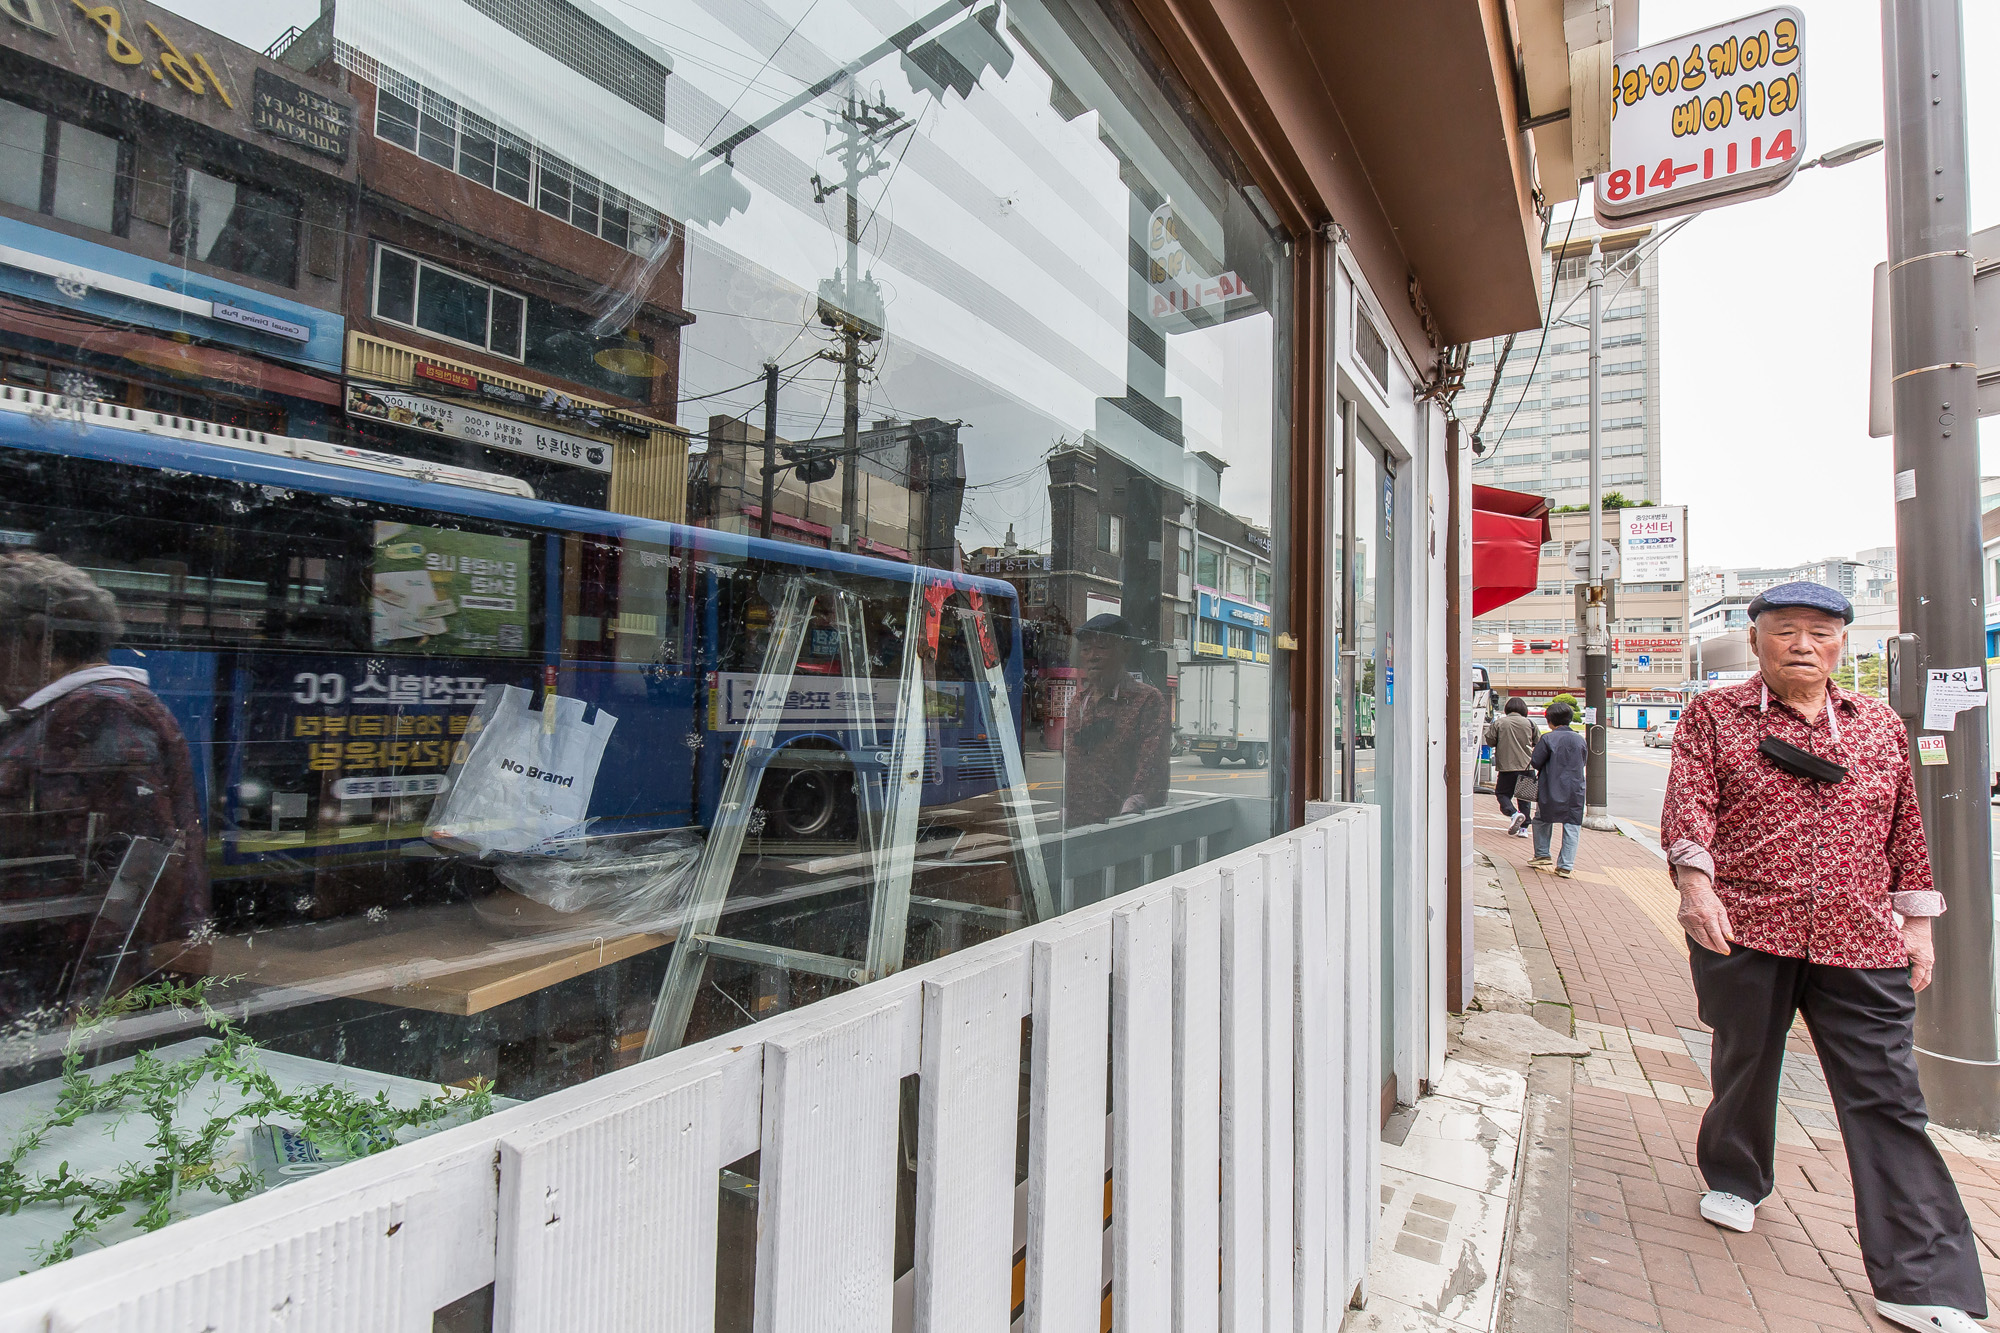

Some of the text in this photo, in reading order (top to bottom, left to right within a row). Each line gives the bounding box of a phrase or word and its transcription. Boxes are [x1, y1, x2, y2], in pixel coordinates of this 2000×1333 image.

[1613, 18, 1800, 121] 라이스케이크
[1672, 72, 1800, 138] 베이커리
[1607, 129, 1796, 201] 814-1114
[1630, 521, 1673, 535] 암센터
[1636, 513, 1668, 521] 중앙대병원
[1624, 638, 1682, 647] EMERGENCY
[1919, 739, 1945, 750] 과외
[500, 758, 574, 788] No Brand
